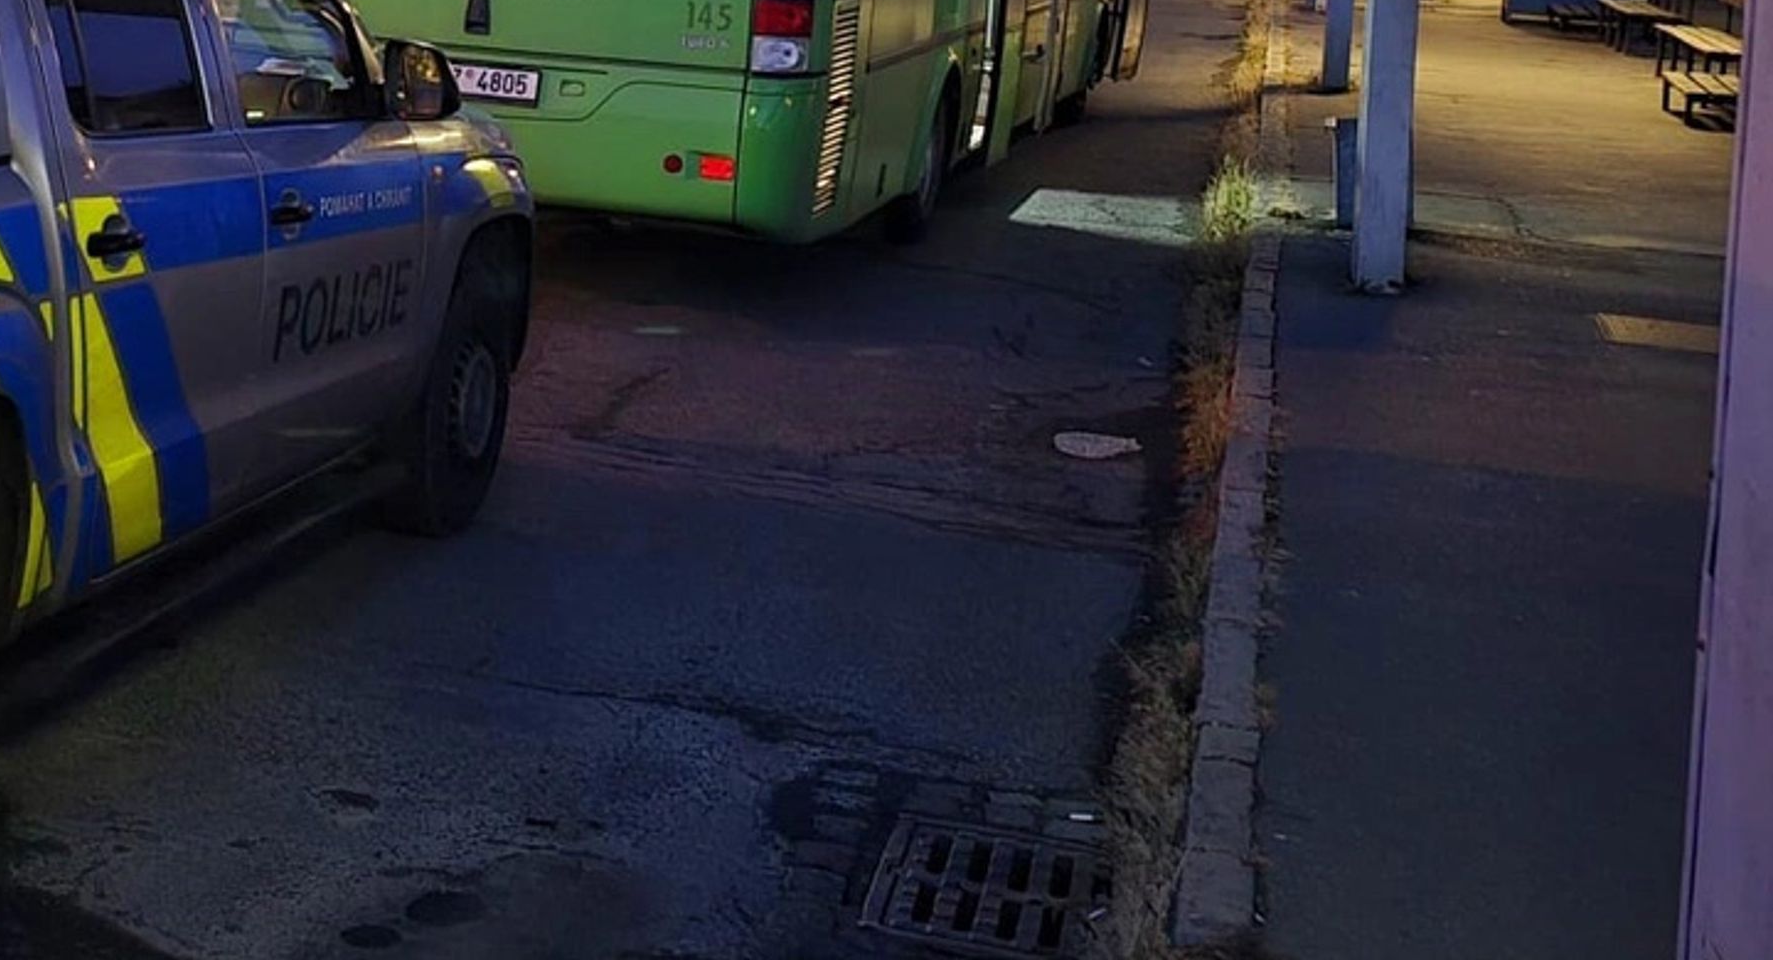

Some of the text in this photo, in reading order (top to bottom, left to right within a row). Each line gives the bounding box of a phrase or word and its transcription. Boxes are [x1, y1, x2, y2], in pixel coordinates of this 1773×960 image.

[687, 0, 733, 31] 145
[477, 69, 527, 95] 4805
[272, 259, 413, 364] POLICIE
